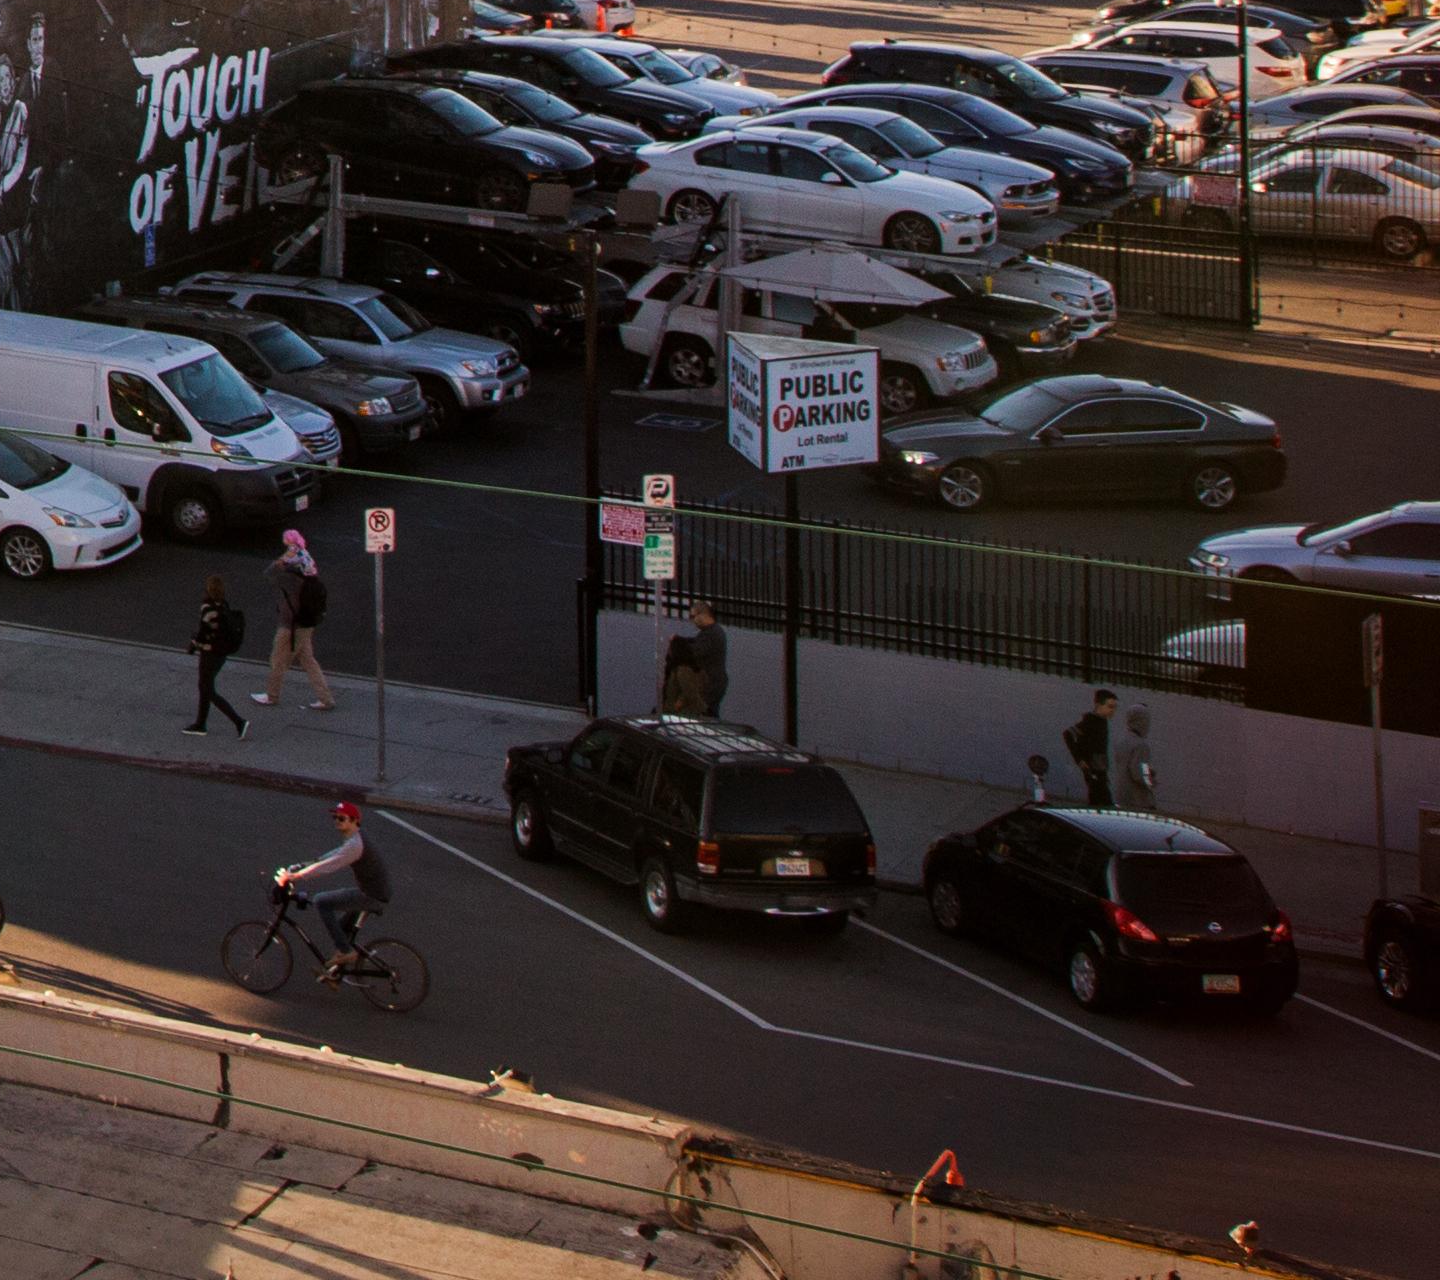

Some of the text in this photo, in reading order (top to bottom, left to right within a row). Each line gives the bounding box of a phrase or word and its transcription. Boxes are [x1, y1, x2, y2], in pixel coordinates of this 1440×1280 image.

[128, 163, 178, 235] OF
[731, 354, 759, 397] PUBLIC
[780, 370, 864, 401] PUBLIC
[772, 398, 871, 433] PARKING
[797, 431, 848, 447] Lot Rental
[781, 454, 805, 468] ATM
